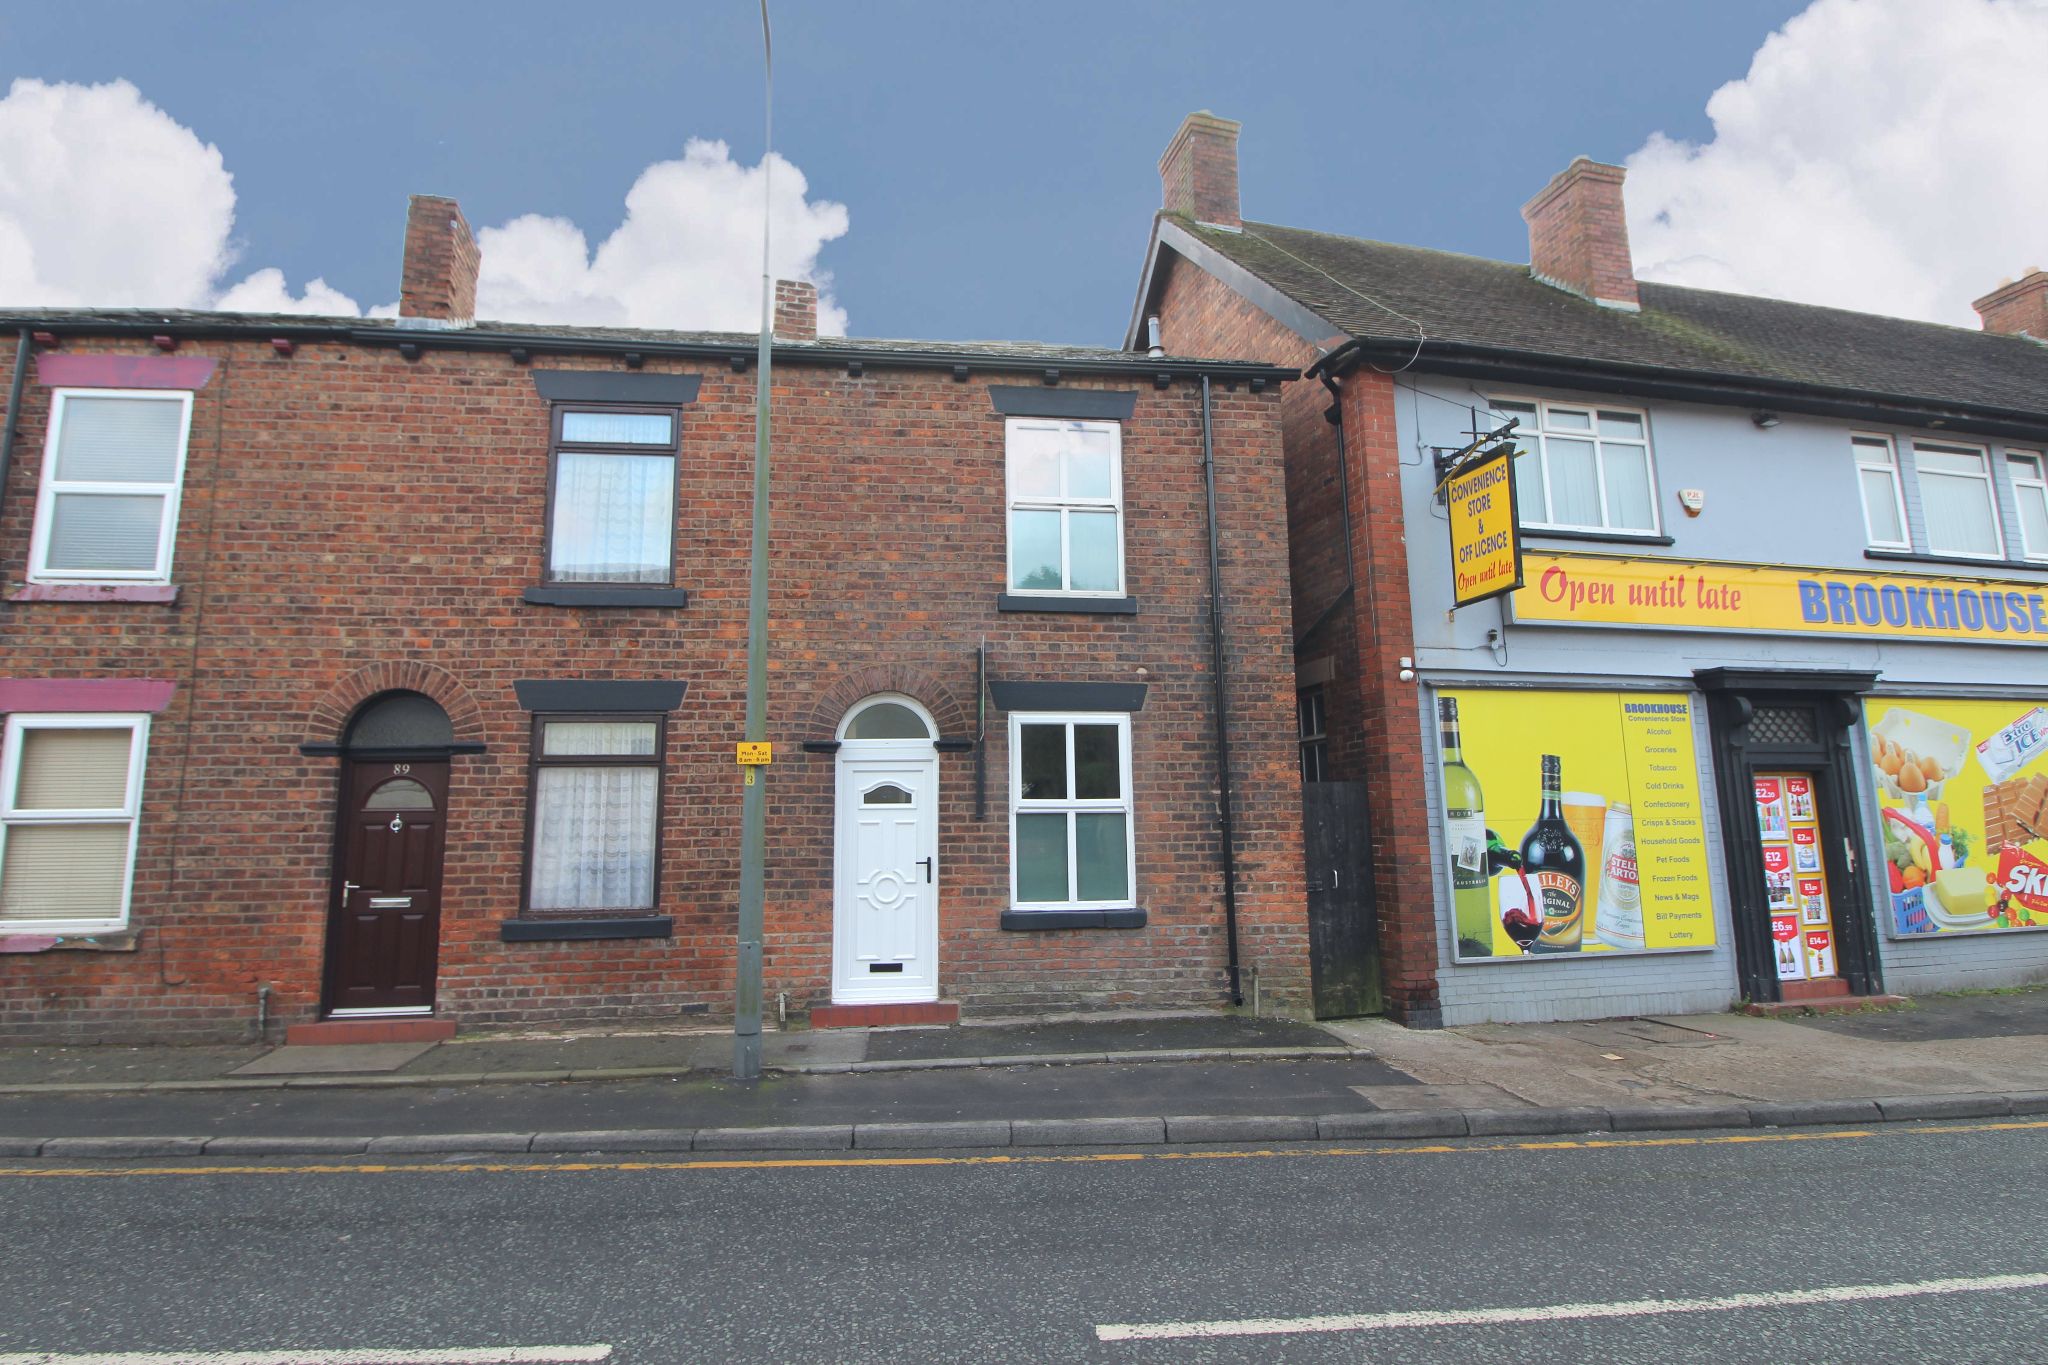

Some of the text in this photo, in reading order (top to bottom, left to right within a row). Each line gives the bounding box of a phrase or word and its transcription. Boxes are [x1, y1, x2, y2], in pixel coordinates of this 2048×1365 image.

[1451, 464, 1506, 503] CONVENIENCE
[1467, 493, 1491, 517] STORE
[1478, 519, 1484, 534] &
[1460, 531, 1507, 563] OFF LICENCE
[1458, 560, 1513, 591] Open until late
[1540, 565, 1742, 611] Open until late
[1797, 579, 2048, 634] BROOKHOUSE
[1624, 704, 1687, 714] BROOKHOUSE
[2003, 720, 2032, 745] Extra
[2015, 728, 2040, 754] ICE
[1645, 745, 1677, 753] Groceries
[394, 763, 410, 775] 89
[1641, 819, 1664, 827] Crisps
[1672, 818, 1696, 826] Snacks
[1641, 837, 1678, 845] Household
[1765, 851, 1781, 862] £12
[1610, 867, 1639, 881] ARTO
[1652, 874, 1675, 882] Frozen
[1541, 874, 1577, 895] ILEYS
[1543, 897, 1571, 908] IGINAL
[1654, 893, 1673, 901] News
[1682, 892, 1699, 901] Mags
[1656, 911, 1702, 920] Bill Payments
[1669, 931, 1694, 939] Lottery
